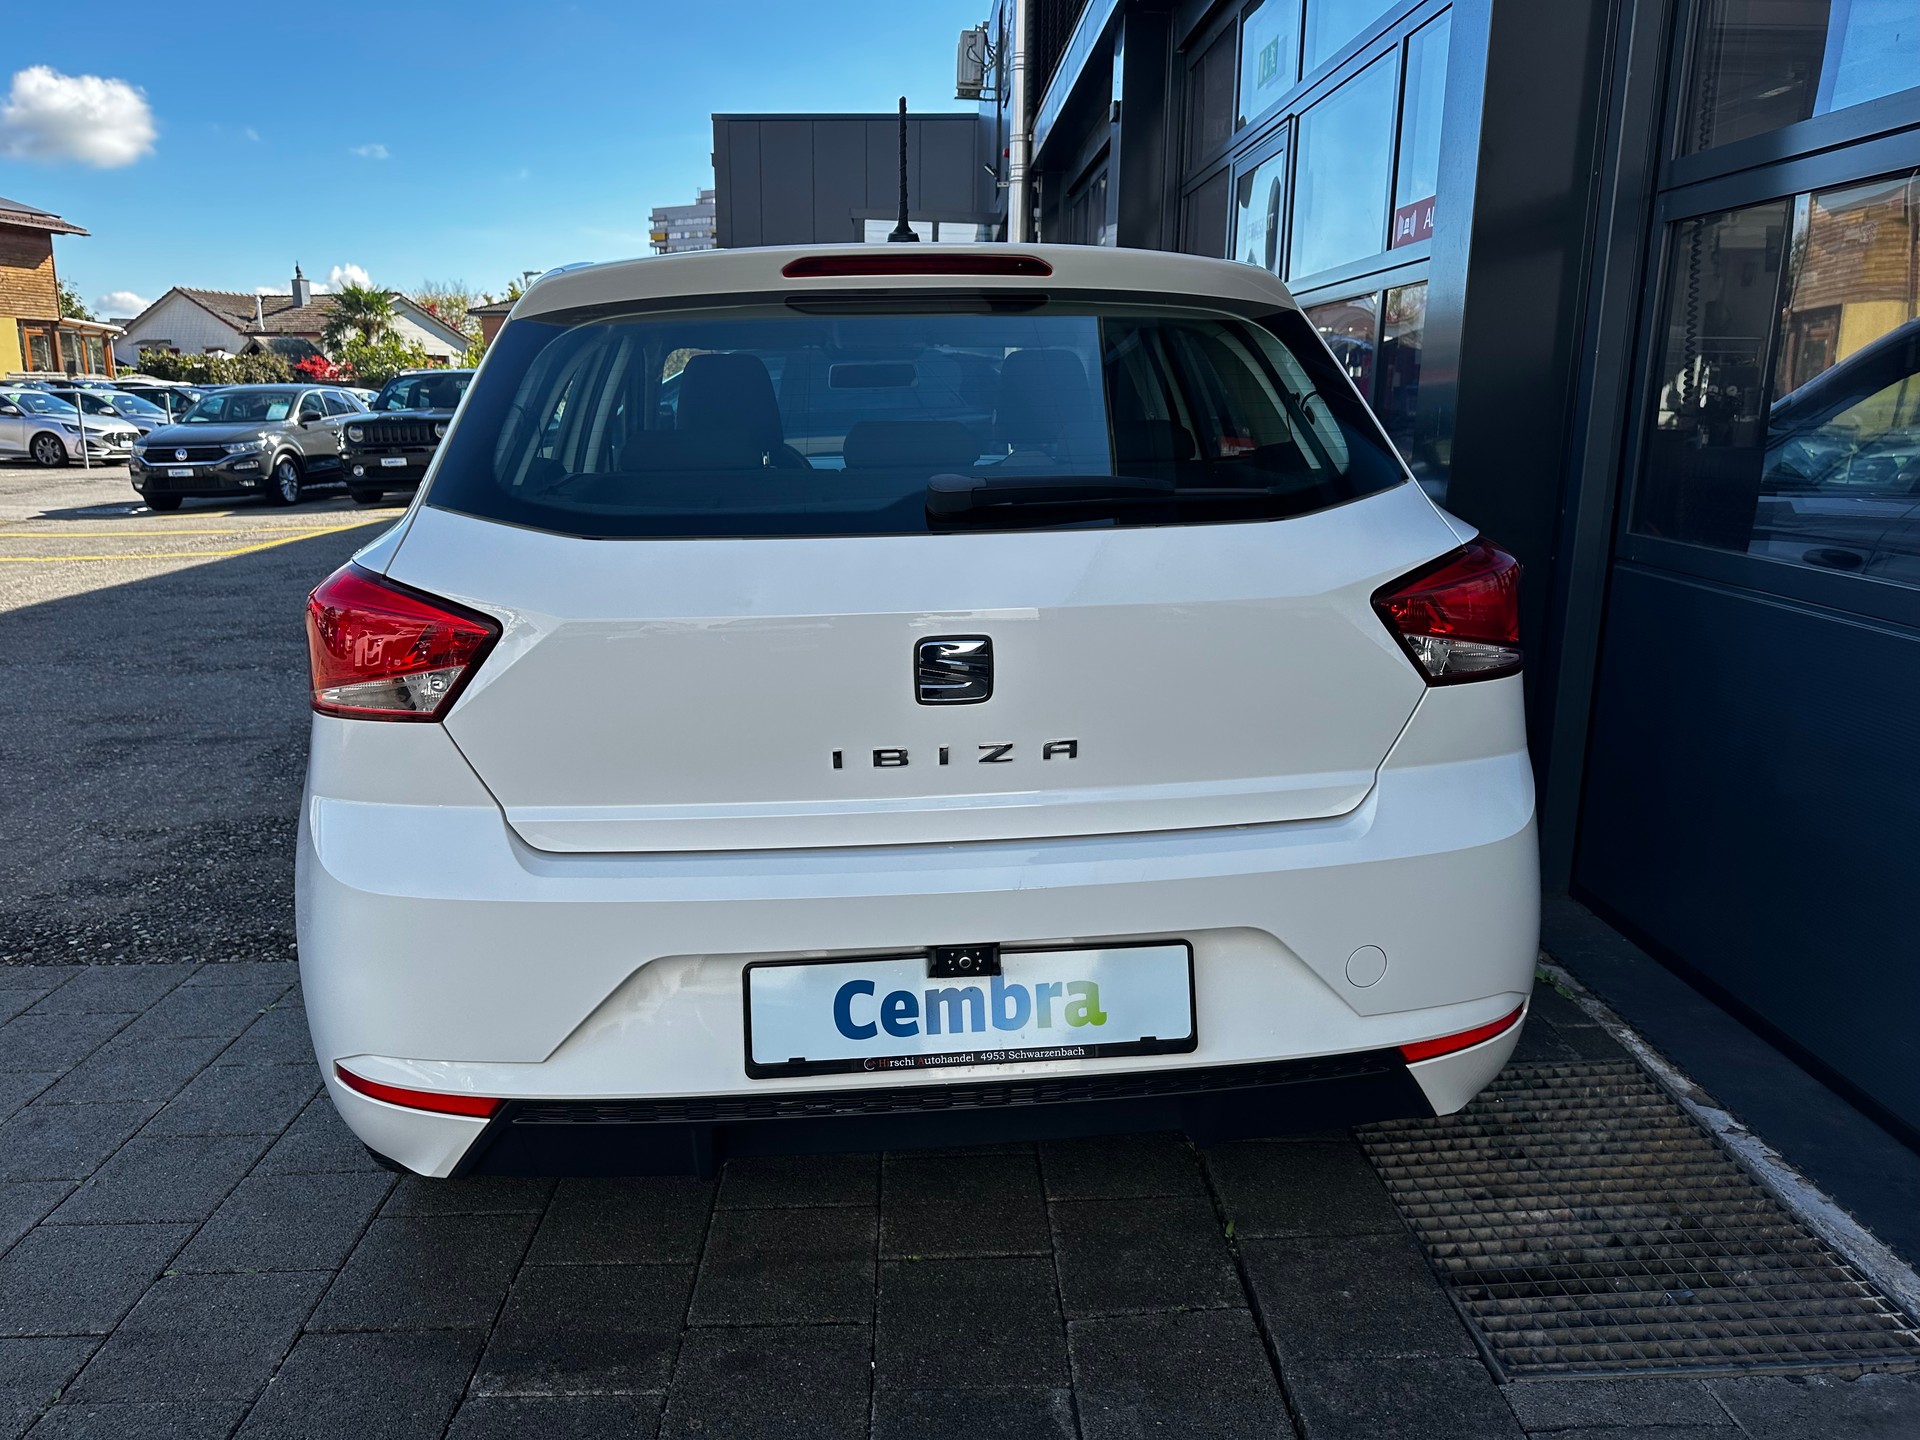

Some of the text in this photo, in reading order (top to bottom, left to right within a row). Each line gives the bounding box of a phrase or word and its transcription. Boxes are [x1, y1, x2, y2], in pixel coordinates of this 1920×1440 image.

[832, 739, 1079, 770] IBIZA
[832, 973, 1108, 1041] Cembra
[878, 1056, 915, 1069] Hirschi
[917, 1053, 975, 1066] Autohandel
[979, 1051, 1006, 1061] 4953
[1008, 1046, 1086, 1060] Schwarzenbach
